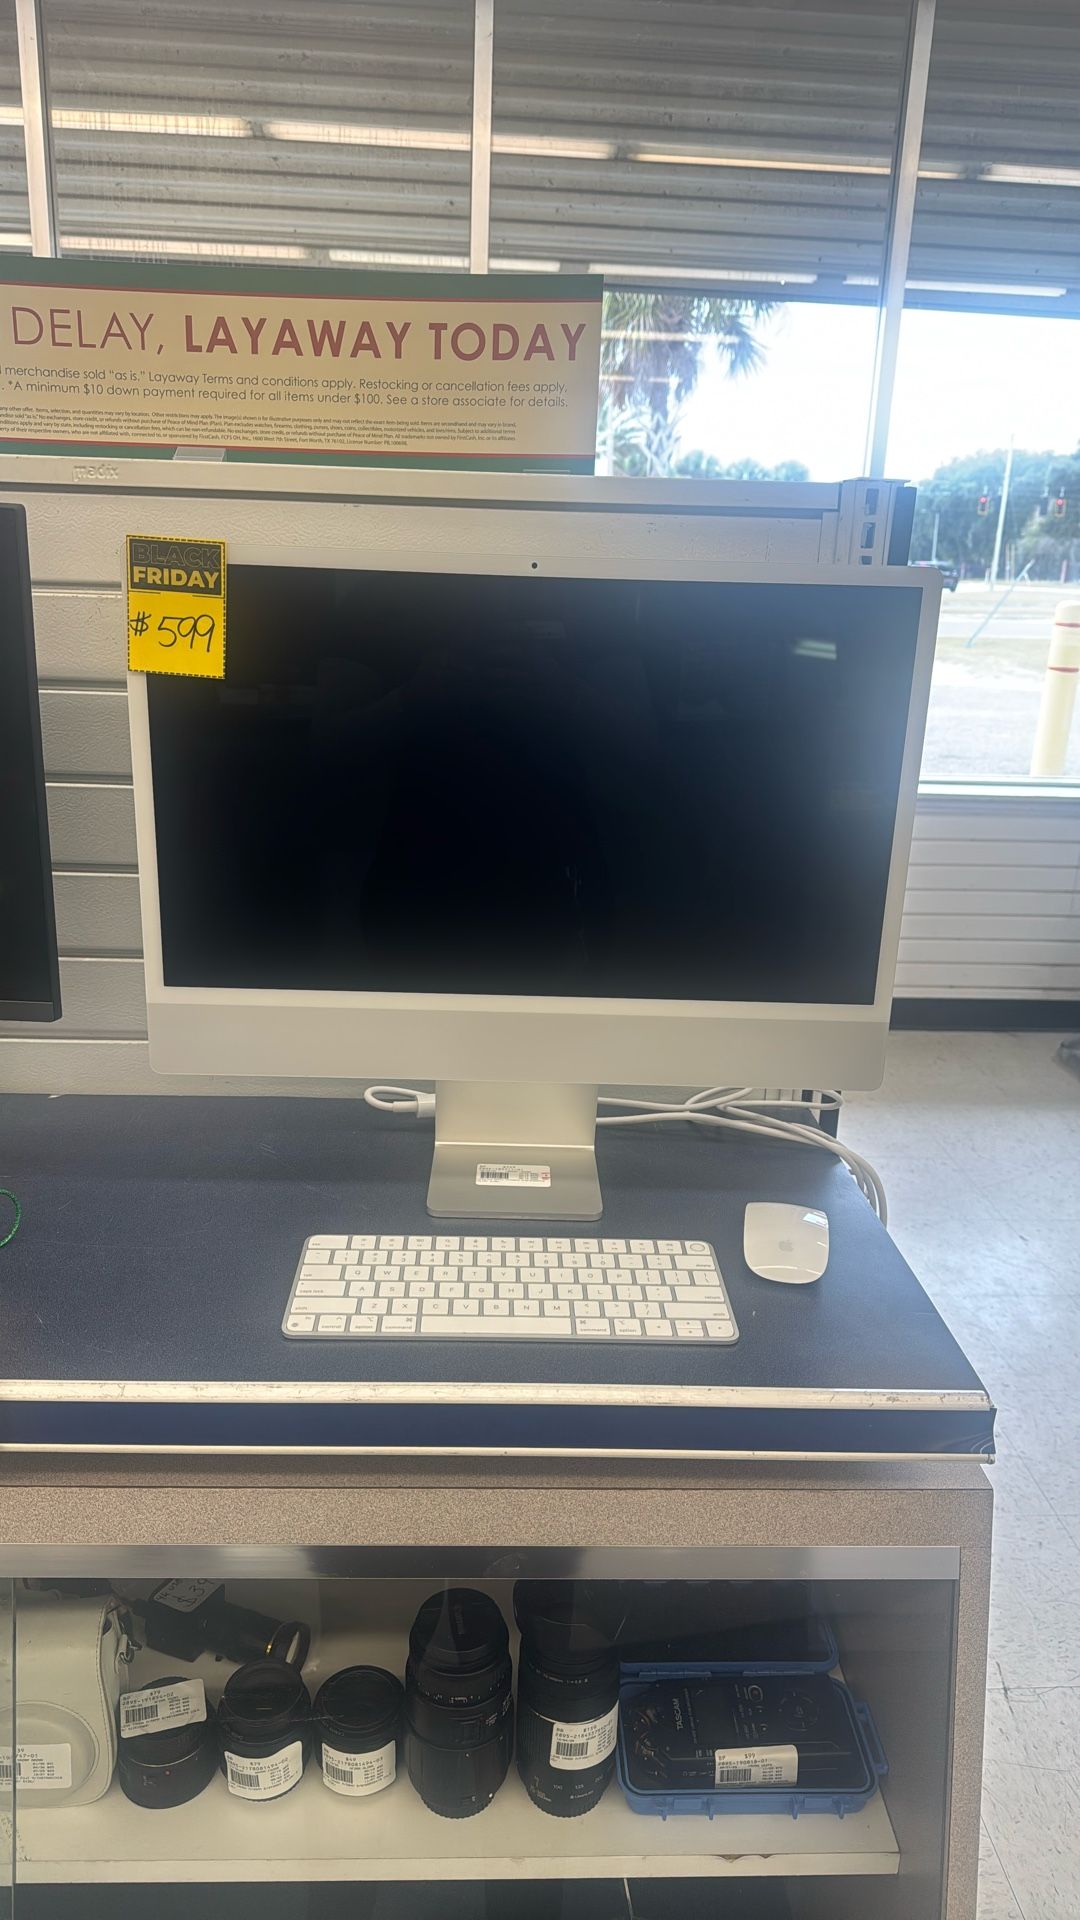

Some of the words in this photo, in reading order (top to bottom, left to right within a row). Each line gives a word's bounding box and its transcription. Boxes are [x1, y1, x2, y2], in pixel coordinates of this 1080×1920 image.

[11, 306, 164, 355] DELAY,
[184, 314, 412, 360] LAYAWAY
[428, 322, 587, 362] TODAY
[5, 366, 80, 379] merchandise
[83, 369, 106, 380] sold
[148, 371, 200, 385] Layaway
[202, 373, 234, 385] Terms
[236, 376, 259, 386] and
[261, 376, 319, 388] conditions
[321, 378, 356, 391] apply.
[359, 378, 419, 393] Restocking
[421, 381, 433, 391] or
[435, 380, 505, 392] cancellation
[507, 380, 530, 392] fees
[26, 381, 80, 394] minimum
[83, 383, 104, 396] $10
[106, 384, 140, 396] down
[143, 387, 196, 400] payment
[198, 388, 247, 401] required
[250, 389, 266, 401] for
[268, 390, 281, 401] all
[284, 390, 314, 402] items
[317, 392, 352, 404] under
[354, 393, 383, 406] $100.
[386, 394, 408, 405] See
[410, 396, 419, 406] a
[421, 395, 450, 406] store
[452, 396, 507, 407] associate
[510, 396, 526, 407] for
[527, 396, 569, 408] details.
[131, 542, 221, 569] BLACK
[133, 566, 219, 589] FRIDAY
